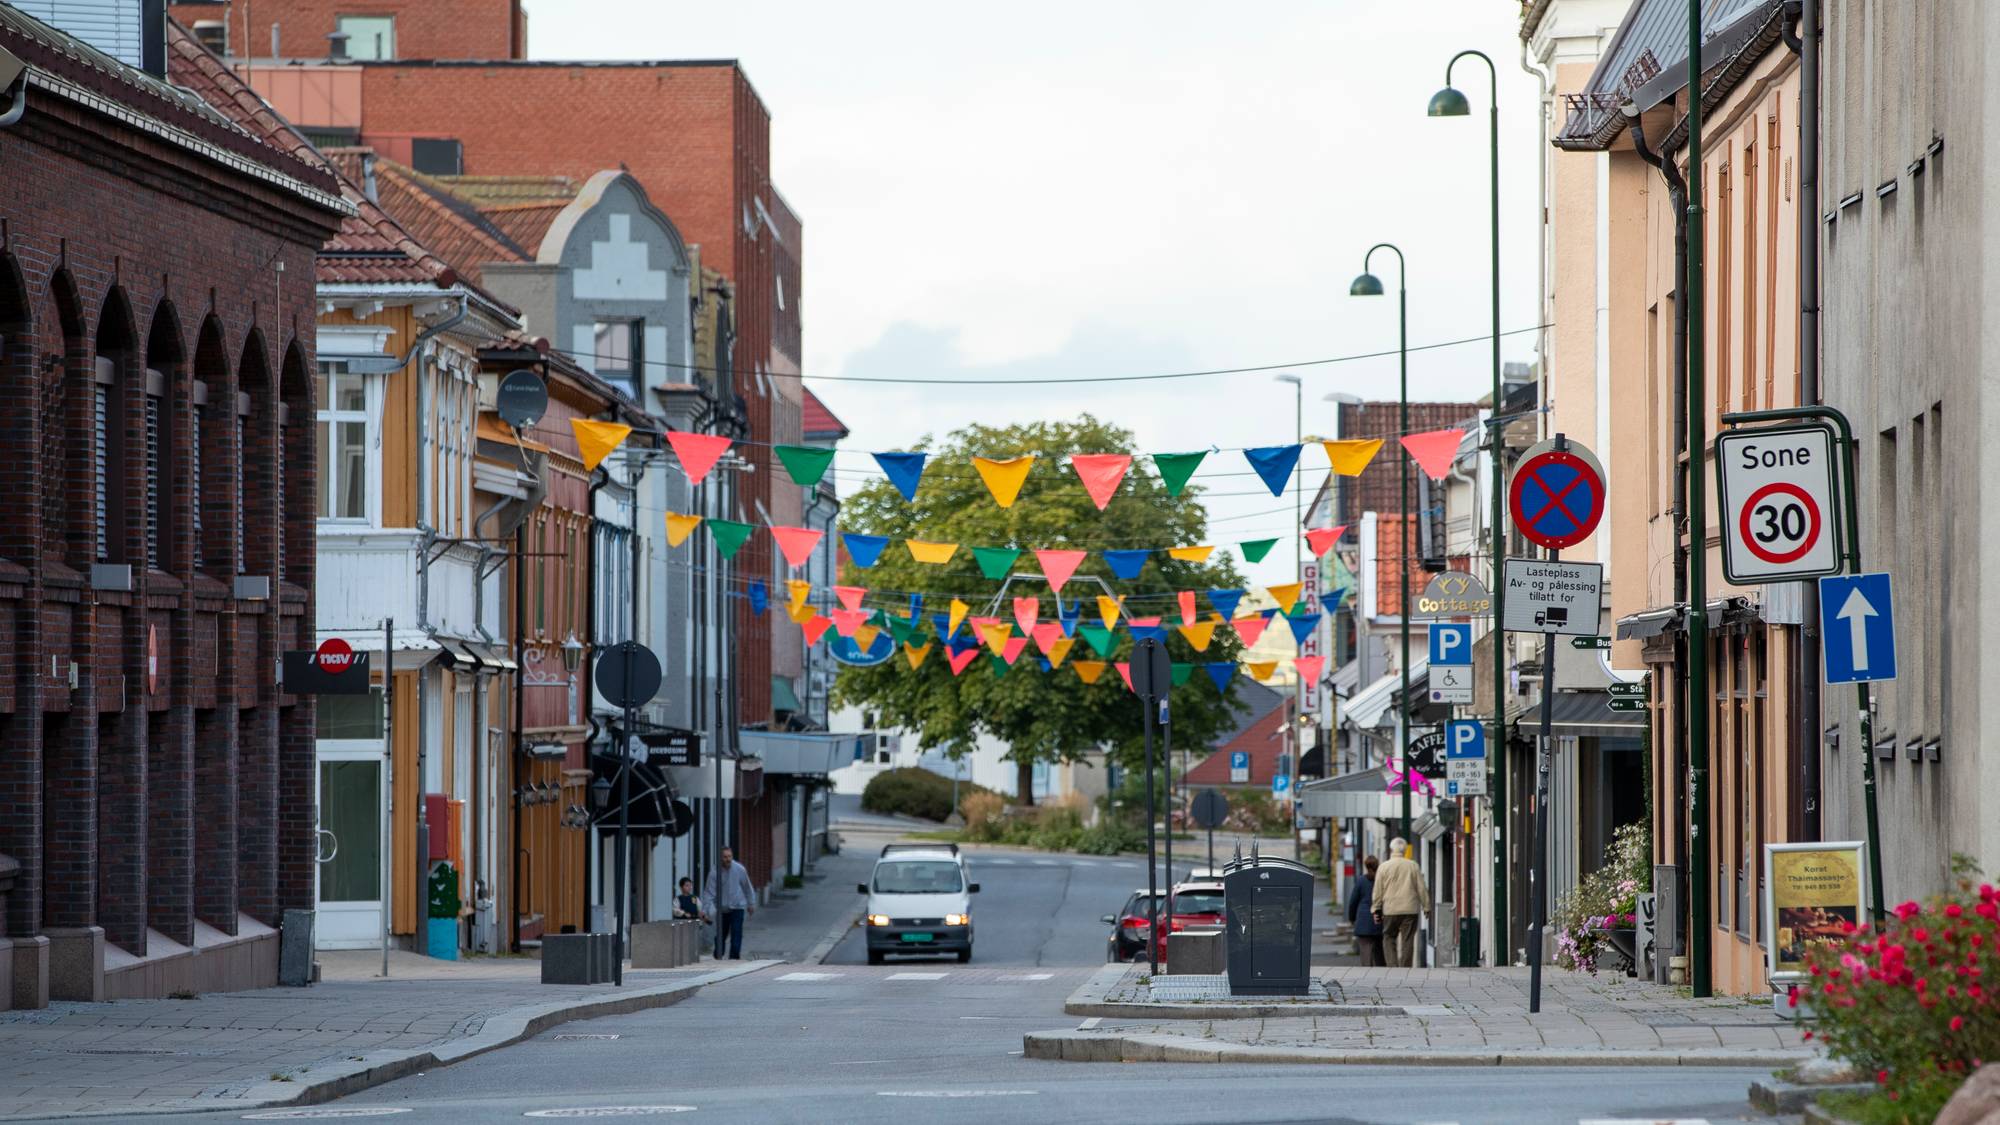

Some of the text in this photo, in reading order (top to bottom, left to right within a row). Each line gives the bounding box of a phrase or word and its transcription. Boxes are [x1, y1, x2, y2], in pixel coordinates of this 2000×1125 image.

[1742, 445, 1811, 470] Sone
[1755, 503, 1806, 543] 30
[1526, 567, 1580, 579] Lasteplass
[1510, 578, 1596, 594] Av- og pålessing
[1419, 597, 1490, 613] Cottage
[1529, 592, 1575, 603] tillatt for
[1439, 629, 1462, 661] P
[1455, 725, 1476, 754] P
